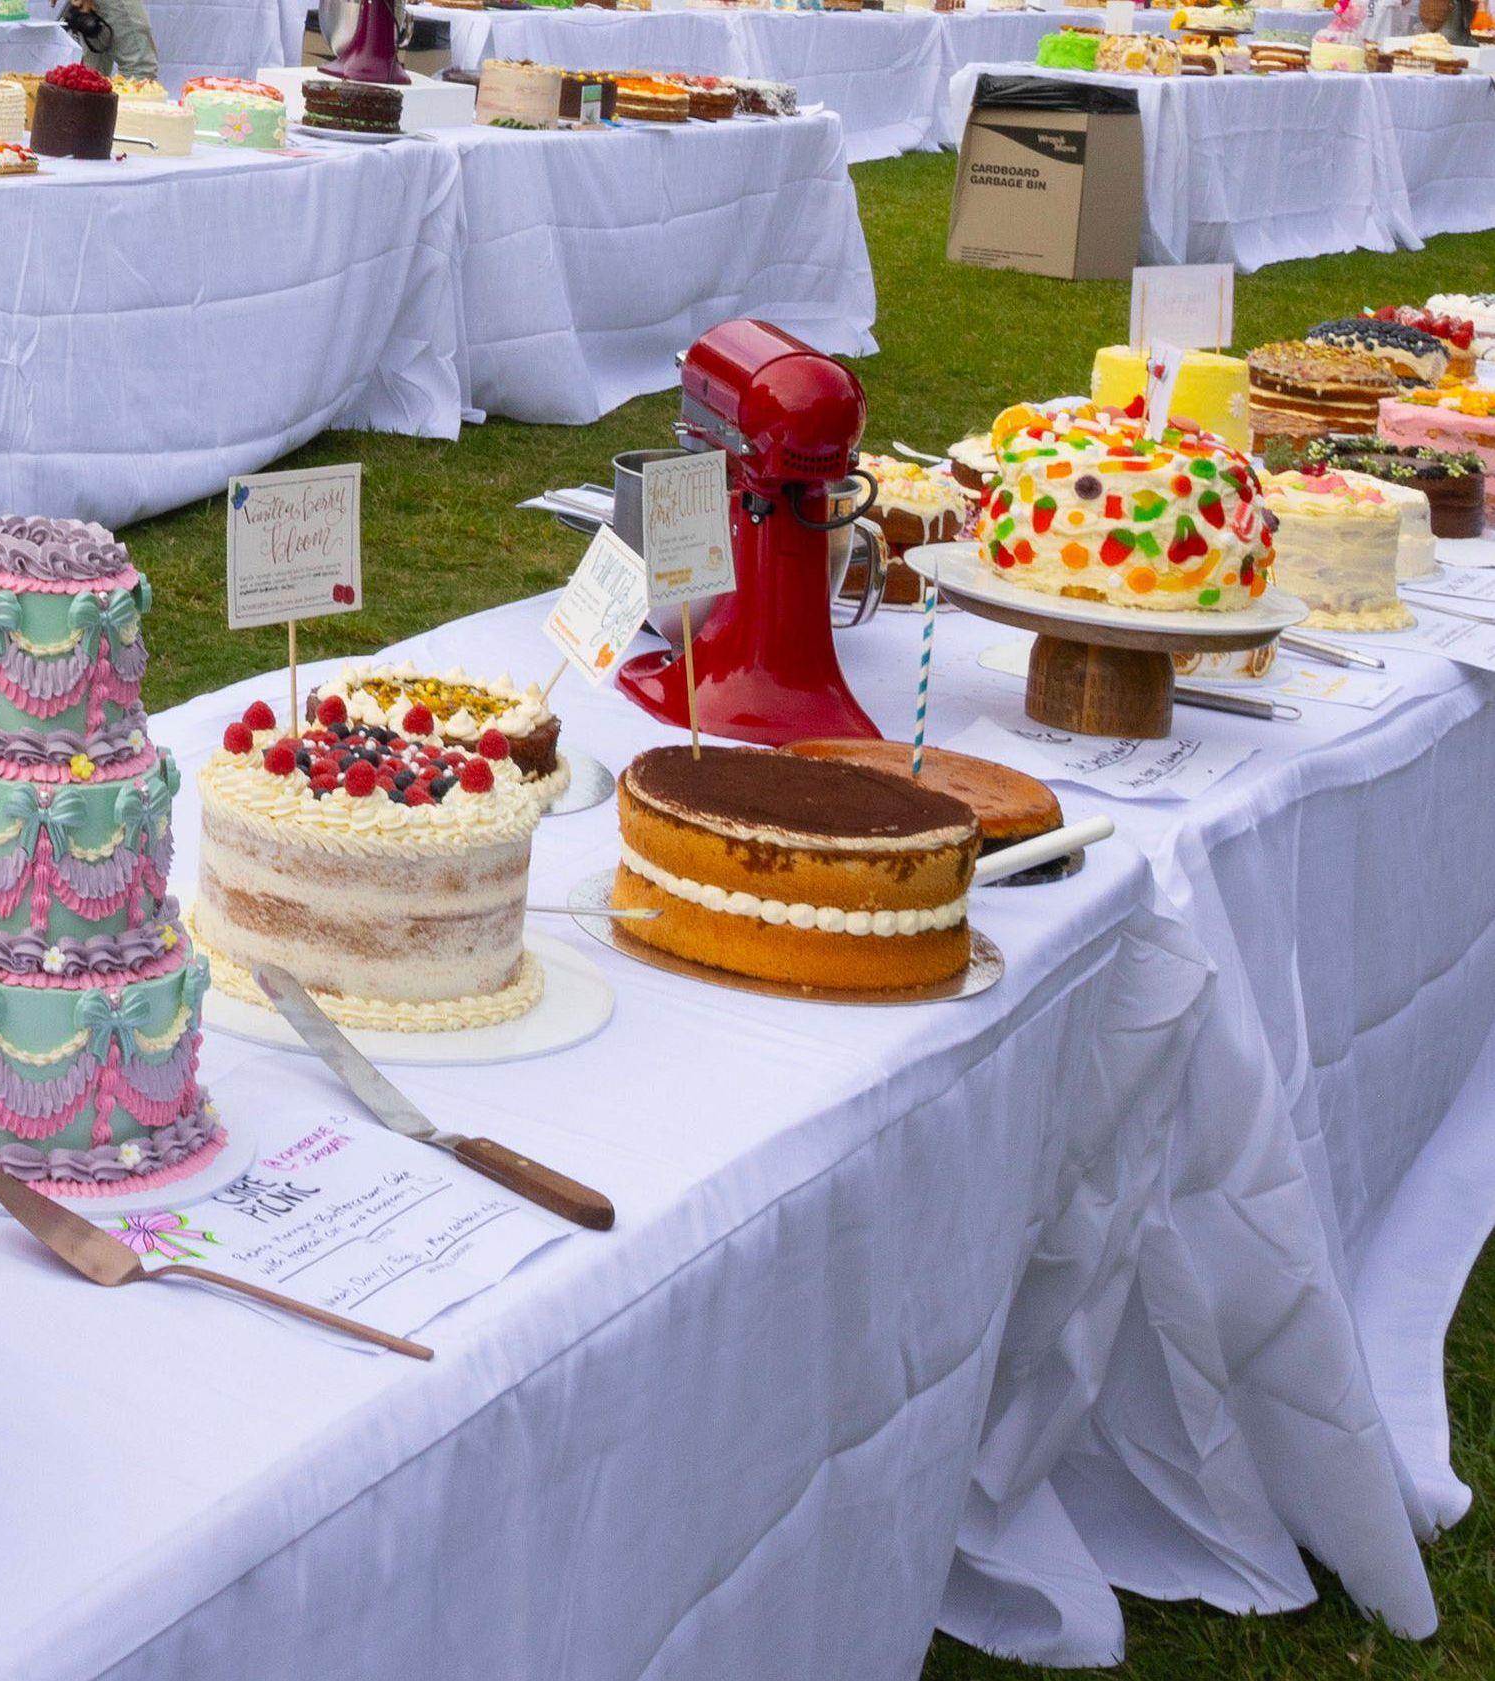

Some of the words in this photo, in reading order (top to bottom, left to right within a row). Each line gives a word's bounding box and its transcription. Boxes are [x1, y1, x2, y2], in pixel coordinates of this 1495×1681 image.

[970, 175, 1023, 188] GARBAGE
[1026, 180, 1047, 191] BIN
[971, 163, 1040, 178] CARDBOARD
[679, 469, 717, 517] COFFEE
[212, 1174, 278, 1205] CAKE
[233, 1181, 321, 1223] PICNIC
